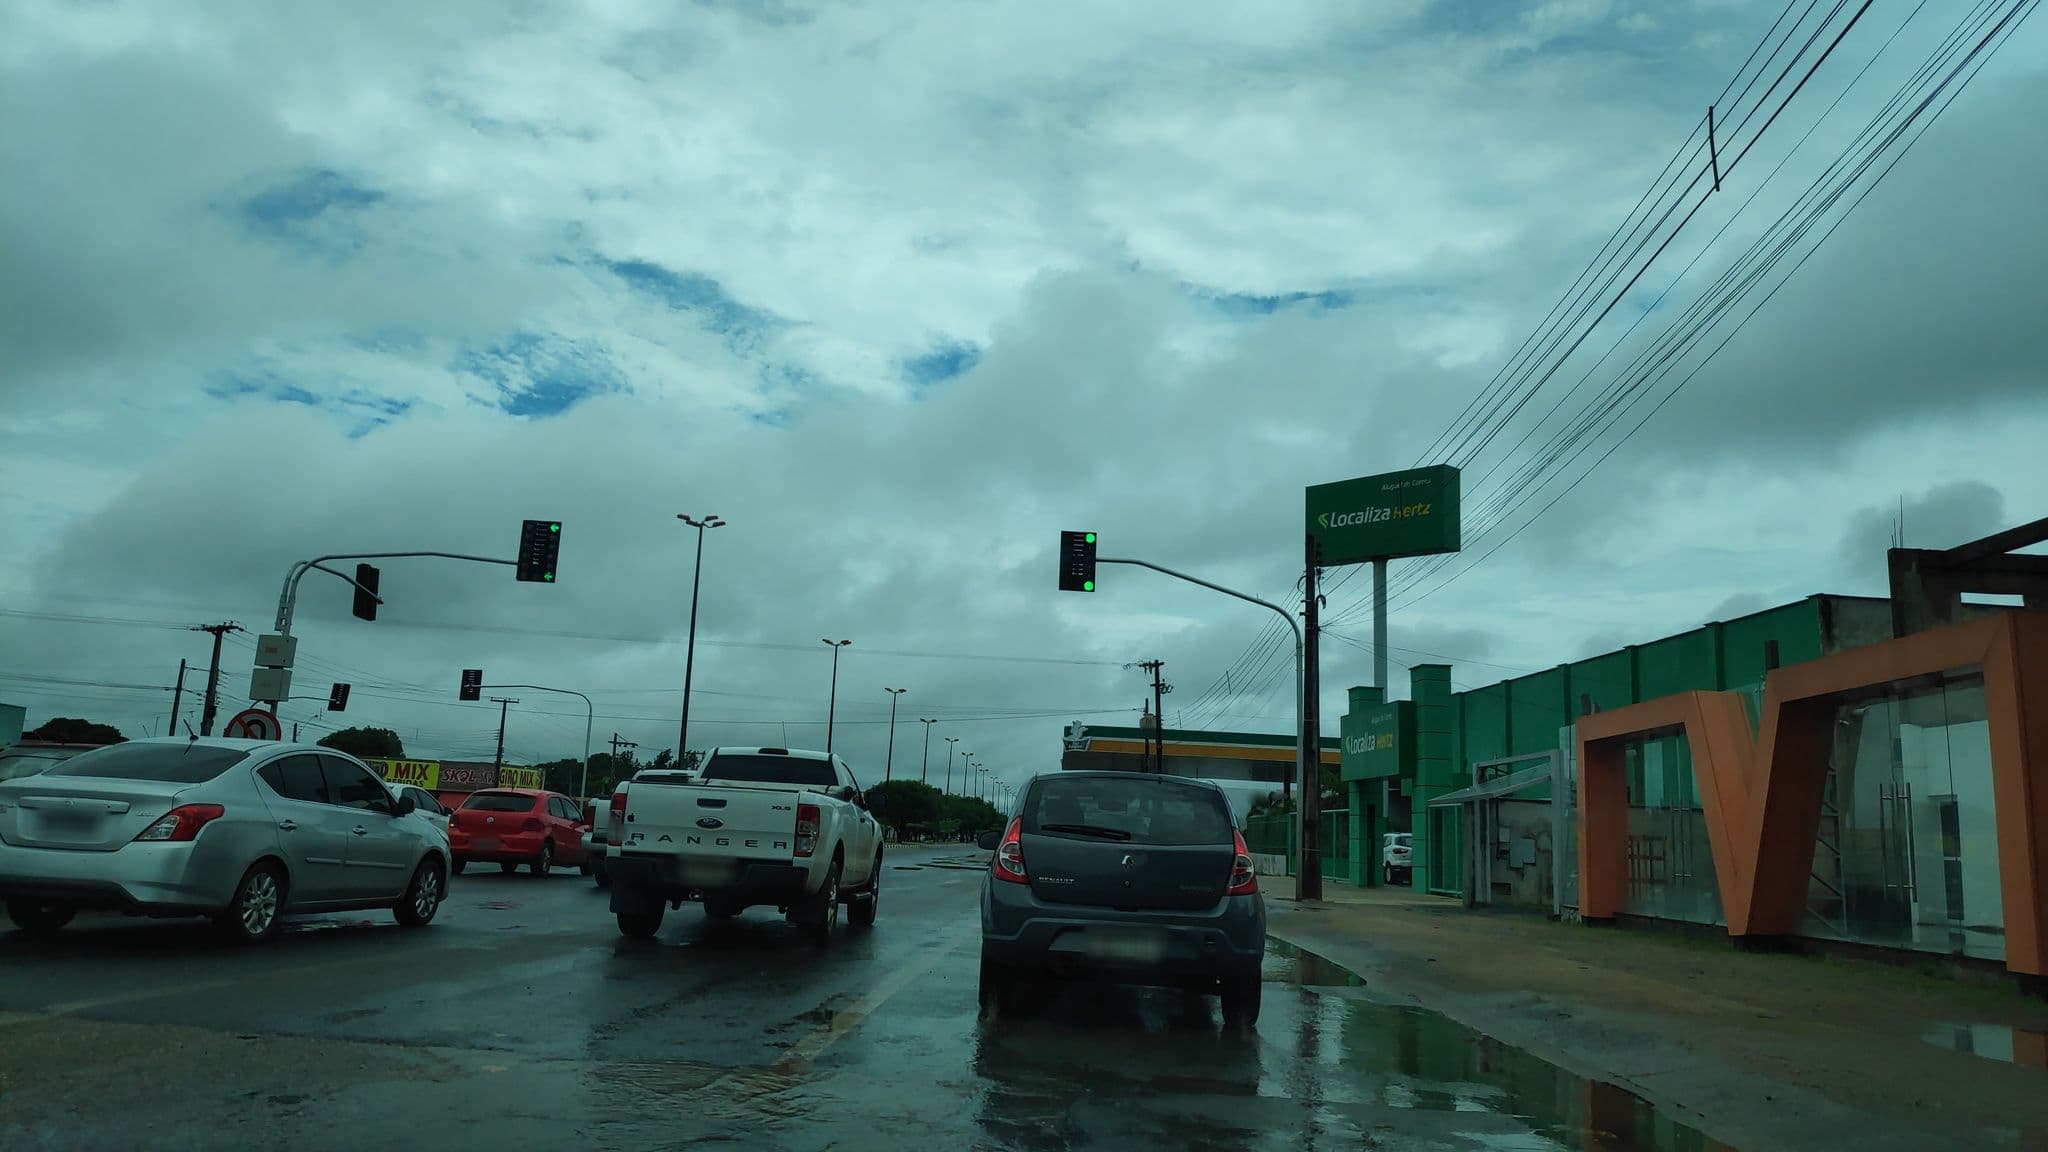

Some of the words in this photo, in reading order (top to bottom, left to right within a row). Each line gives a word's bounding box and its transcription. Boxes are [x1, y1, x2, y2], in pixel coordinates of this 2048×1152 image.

[1330, 506, 1391, 528] Localiza
[1392, 502, 1432, 520] Hertz
[1350, 731, 1376, 755] Localiza
[394, 762, 430, 780] MIX
[499, 768, 518, 785] GIRO
[520, 770, 533, 786] MIX
[631, 832, 787, 849] RANGER
